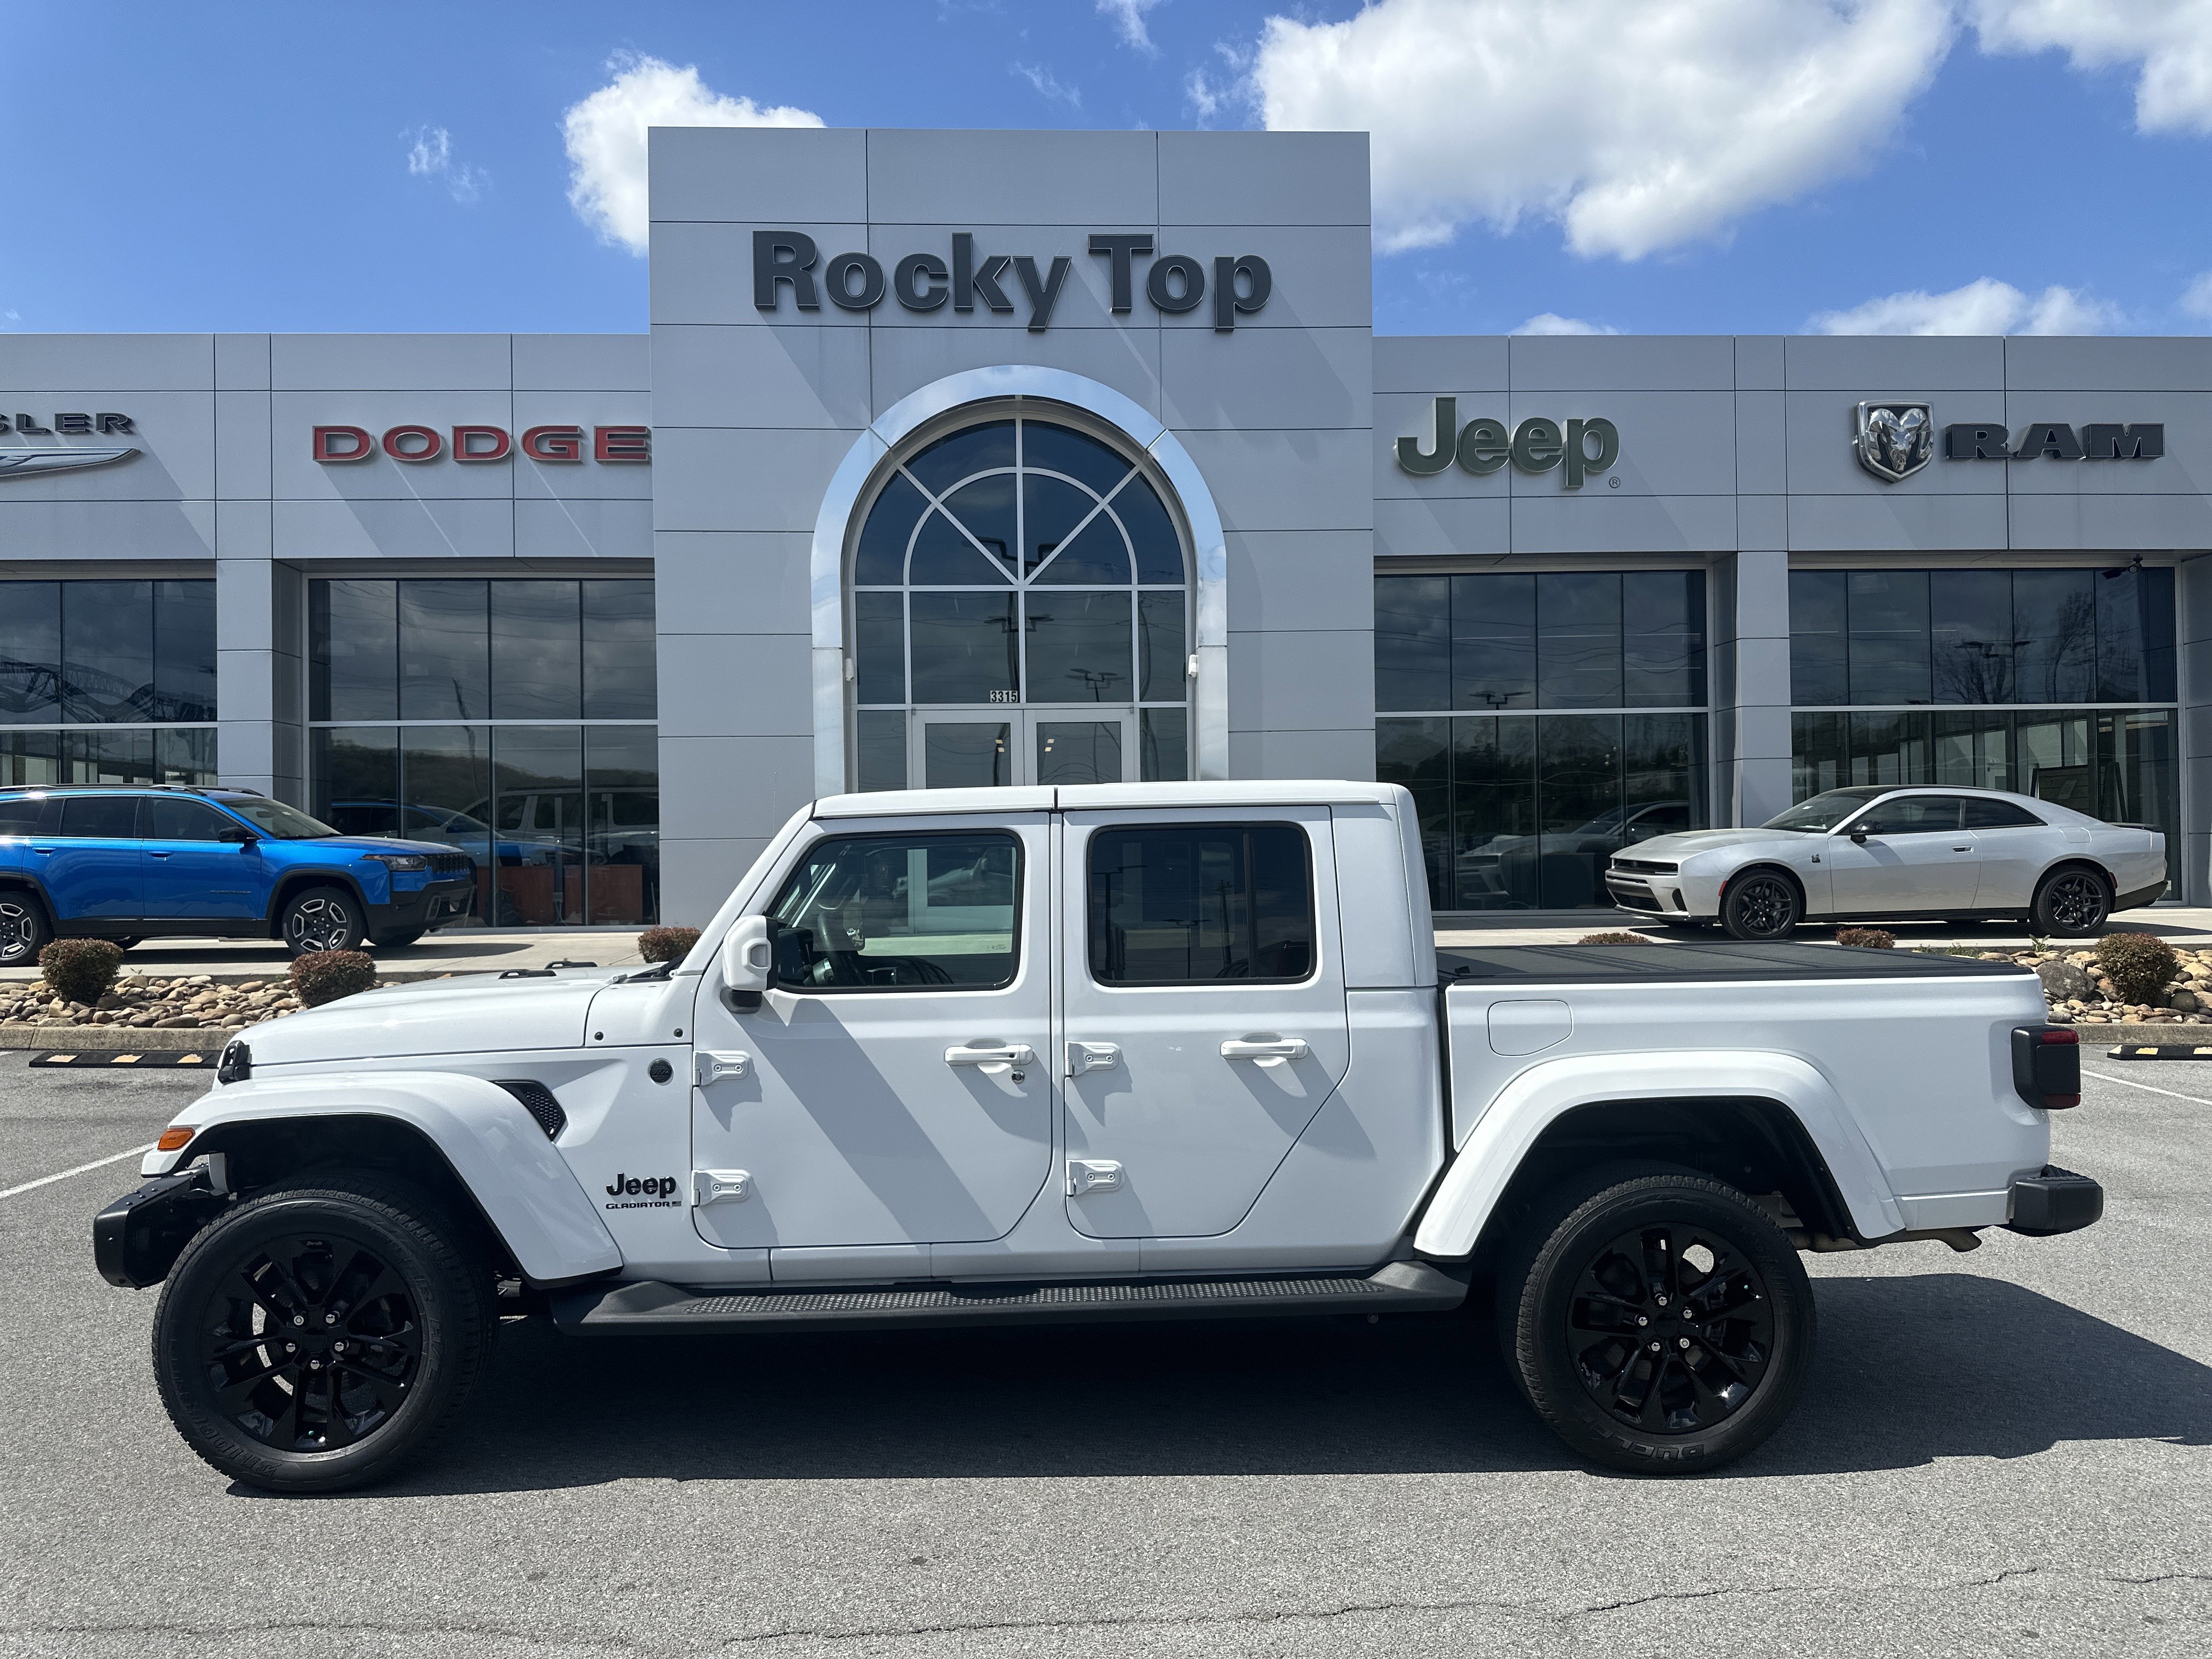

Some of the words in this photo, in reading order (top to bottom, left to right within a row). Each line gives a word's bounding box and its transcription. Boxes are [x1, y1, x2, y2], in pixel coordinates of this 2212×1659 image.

[752, 230, 1072, 331] Rocky
[1088, 233, 1273, 331] Top
[0, 413, 132, 434] LER
[312, 425, 652, 462] DODGE
[1395, 397, 1620, 489] Jeep
[1946, 423, 2165, 460] RAM
[991, 691, 1017, 702] 3315
[606, 1172, 676, 1199] Jeep
[606, 1201, 670, 1210] GLADIATOR
